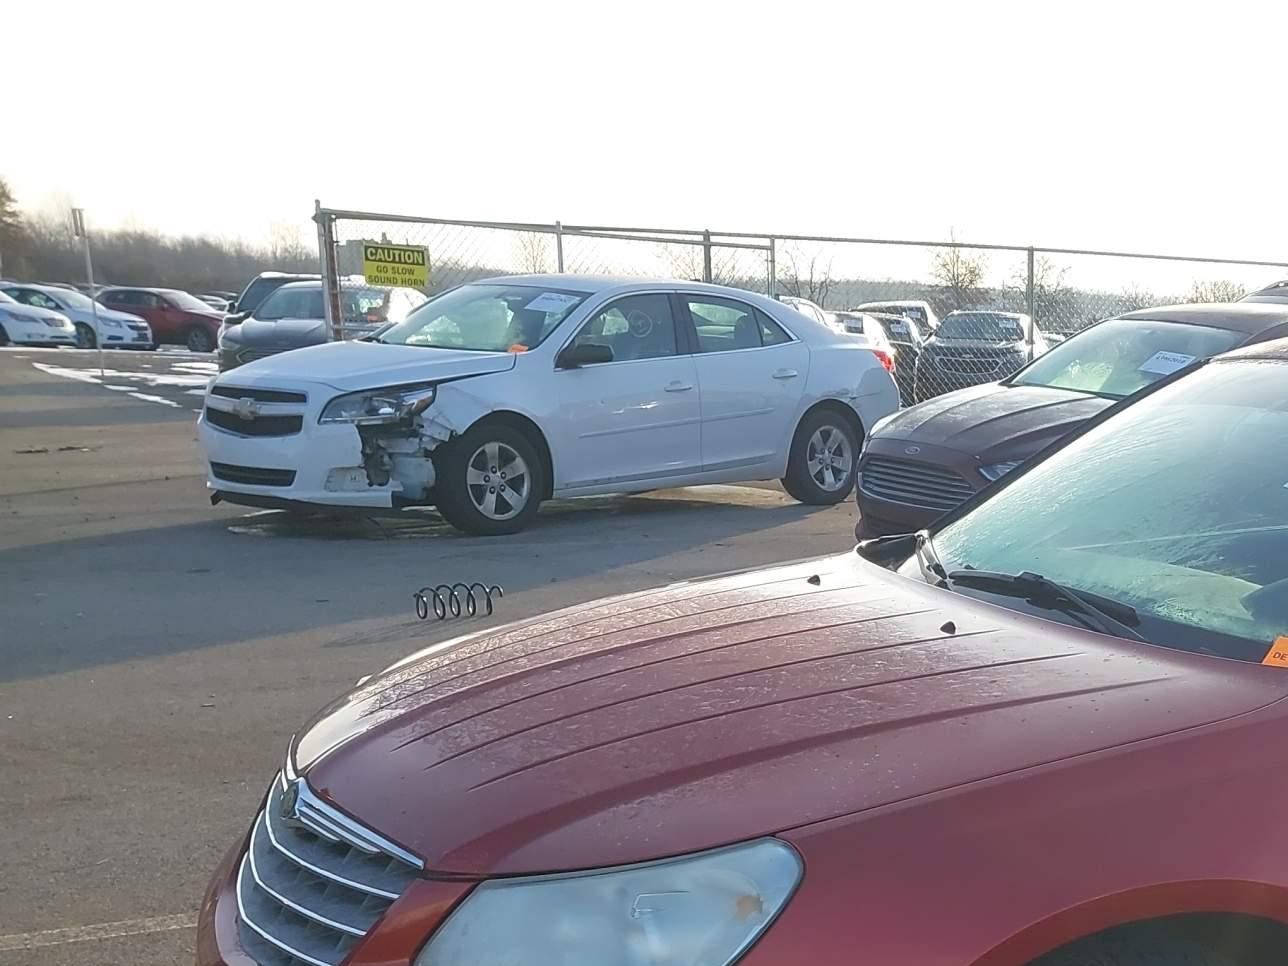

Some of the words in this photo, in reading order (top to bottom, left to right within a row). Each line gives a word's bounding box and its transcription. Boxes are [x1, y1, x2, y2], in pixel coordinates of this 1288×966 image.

[368, 249, 422, 263] CAUTION
[376, 265, 388, 274] GO
[392, 267, 415, 276] SLOW
[368, 275, 398, 285] SOUND
[401, 278, 425, 287] HORN
